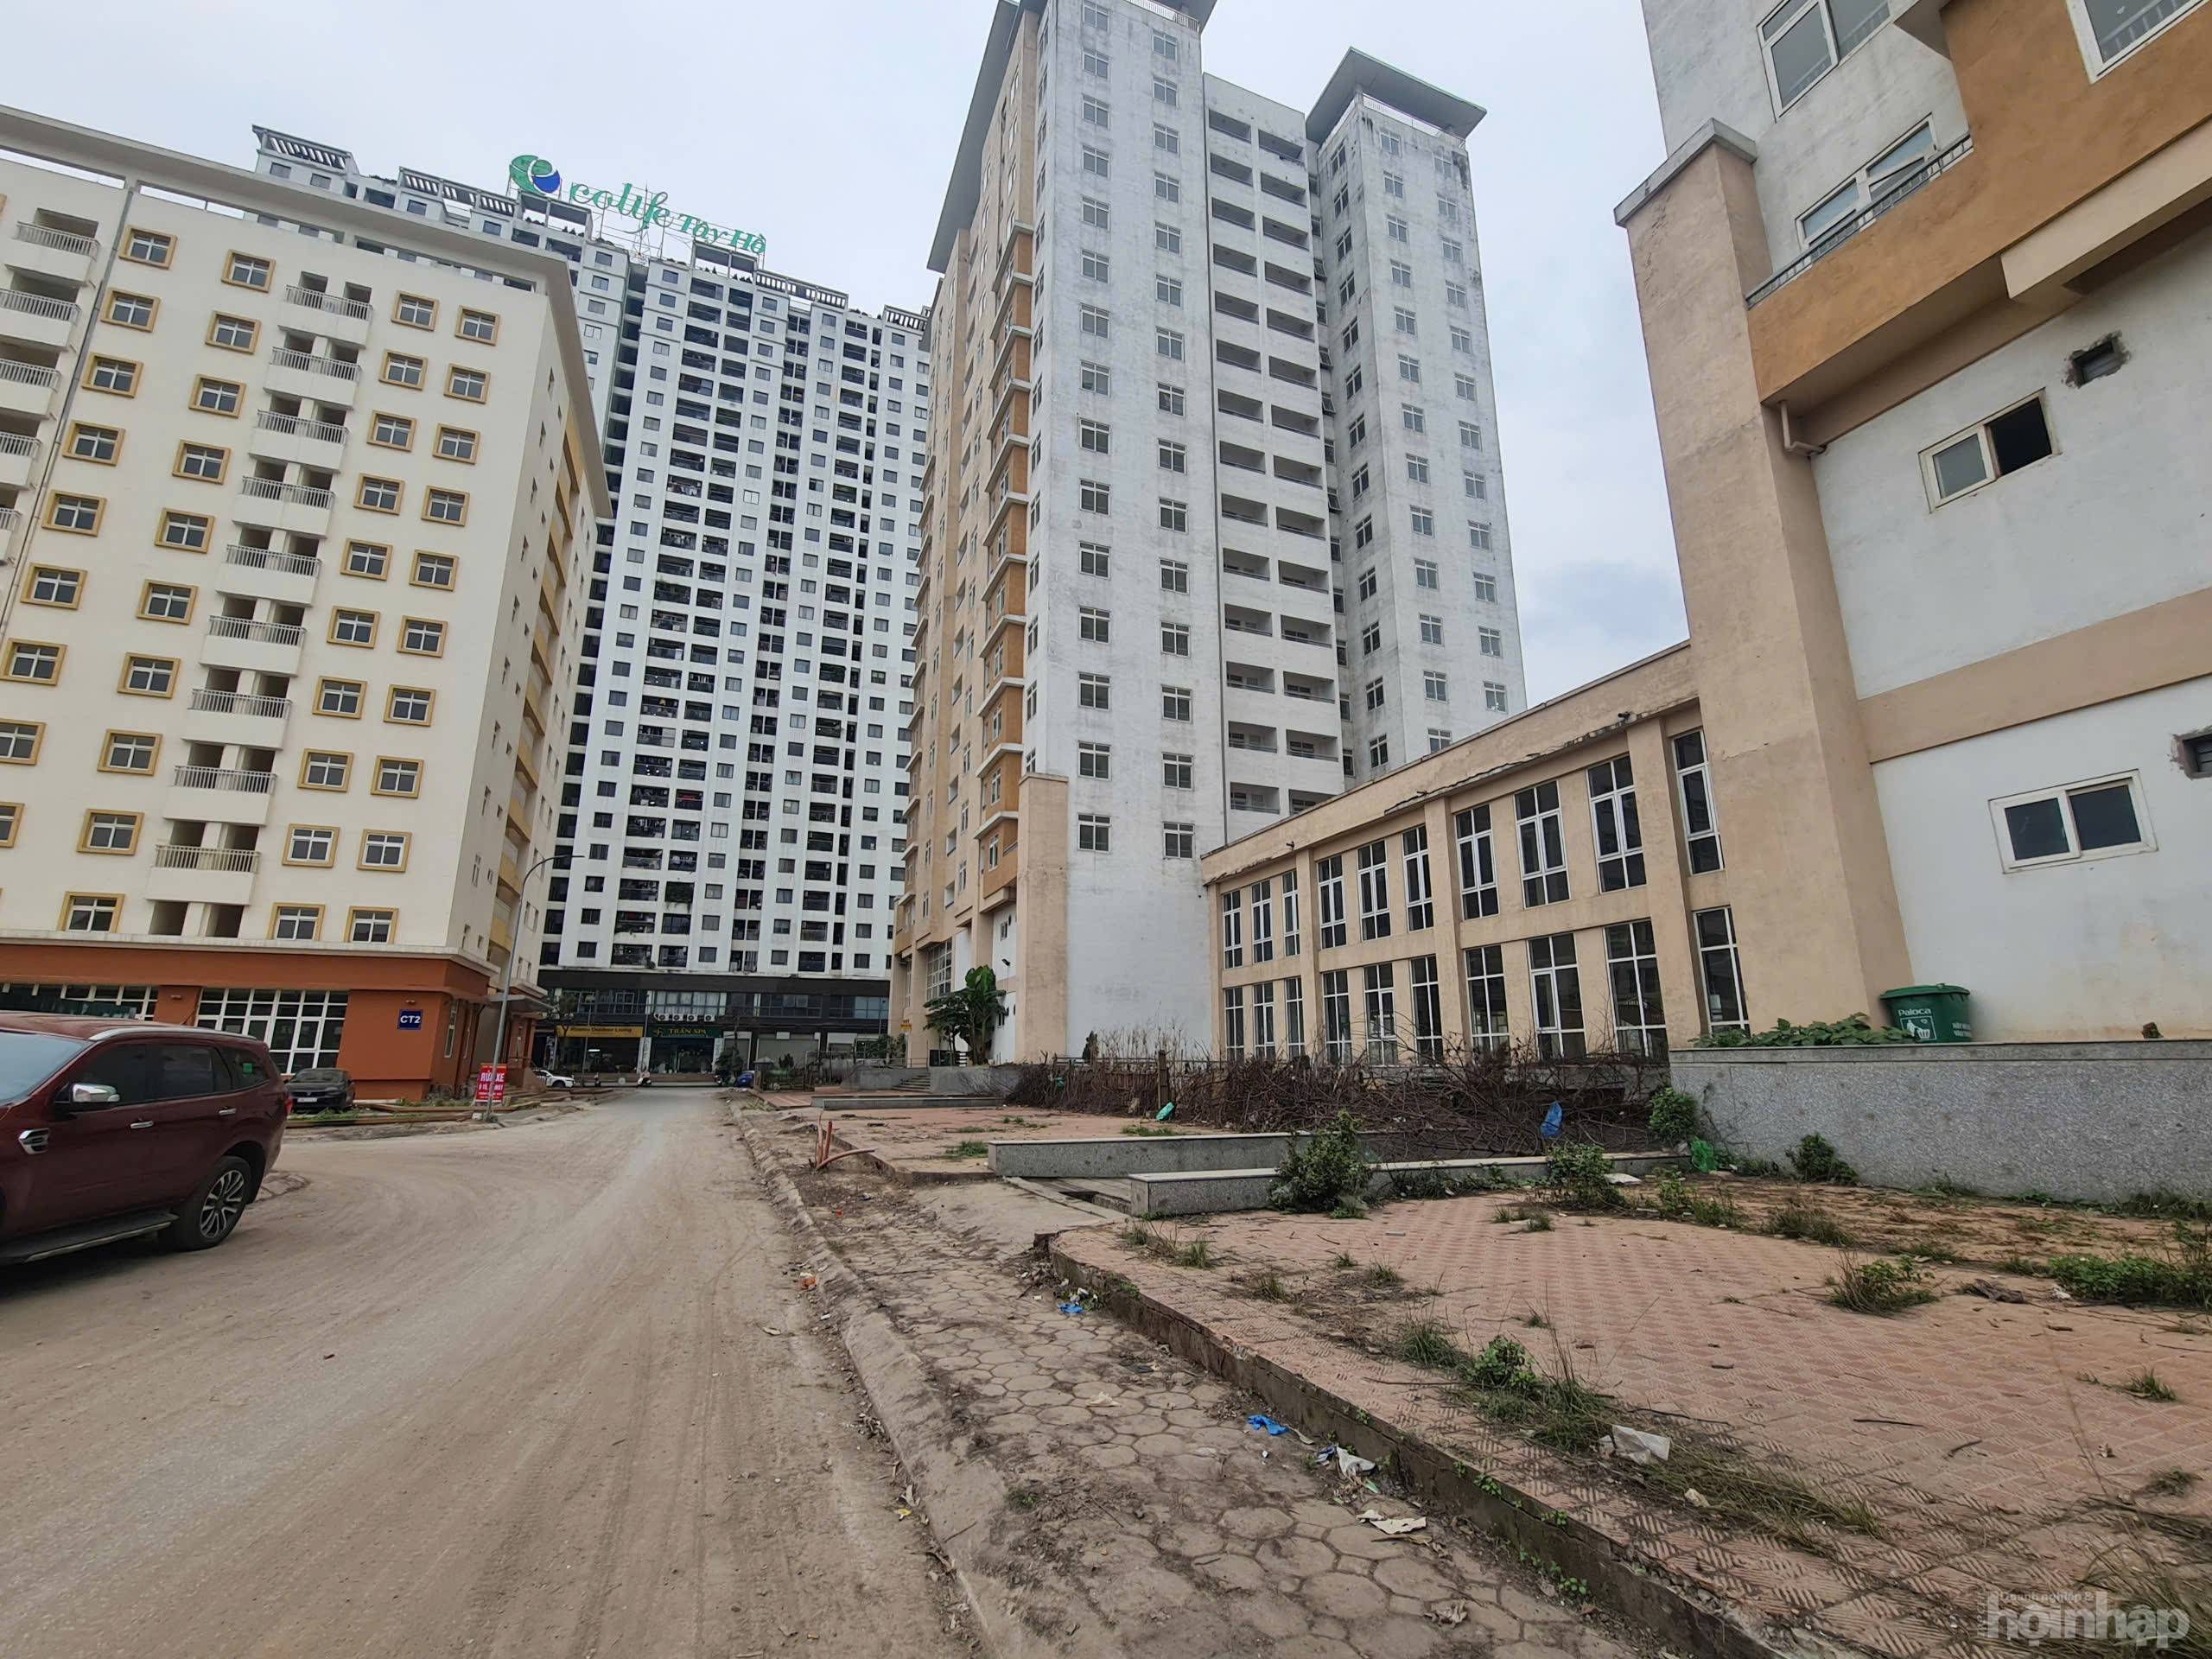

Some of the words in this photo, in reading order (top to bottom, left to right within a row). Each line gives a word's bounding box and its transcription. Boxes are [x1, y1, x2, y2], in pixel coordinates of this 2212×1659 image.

[678, 213, 728, 245] Tây
[400, 1015, 421, 1024] CT2
[495, 1072, 505, 1083] XE
